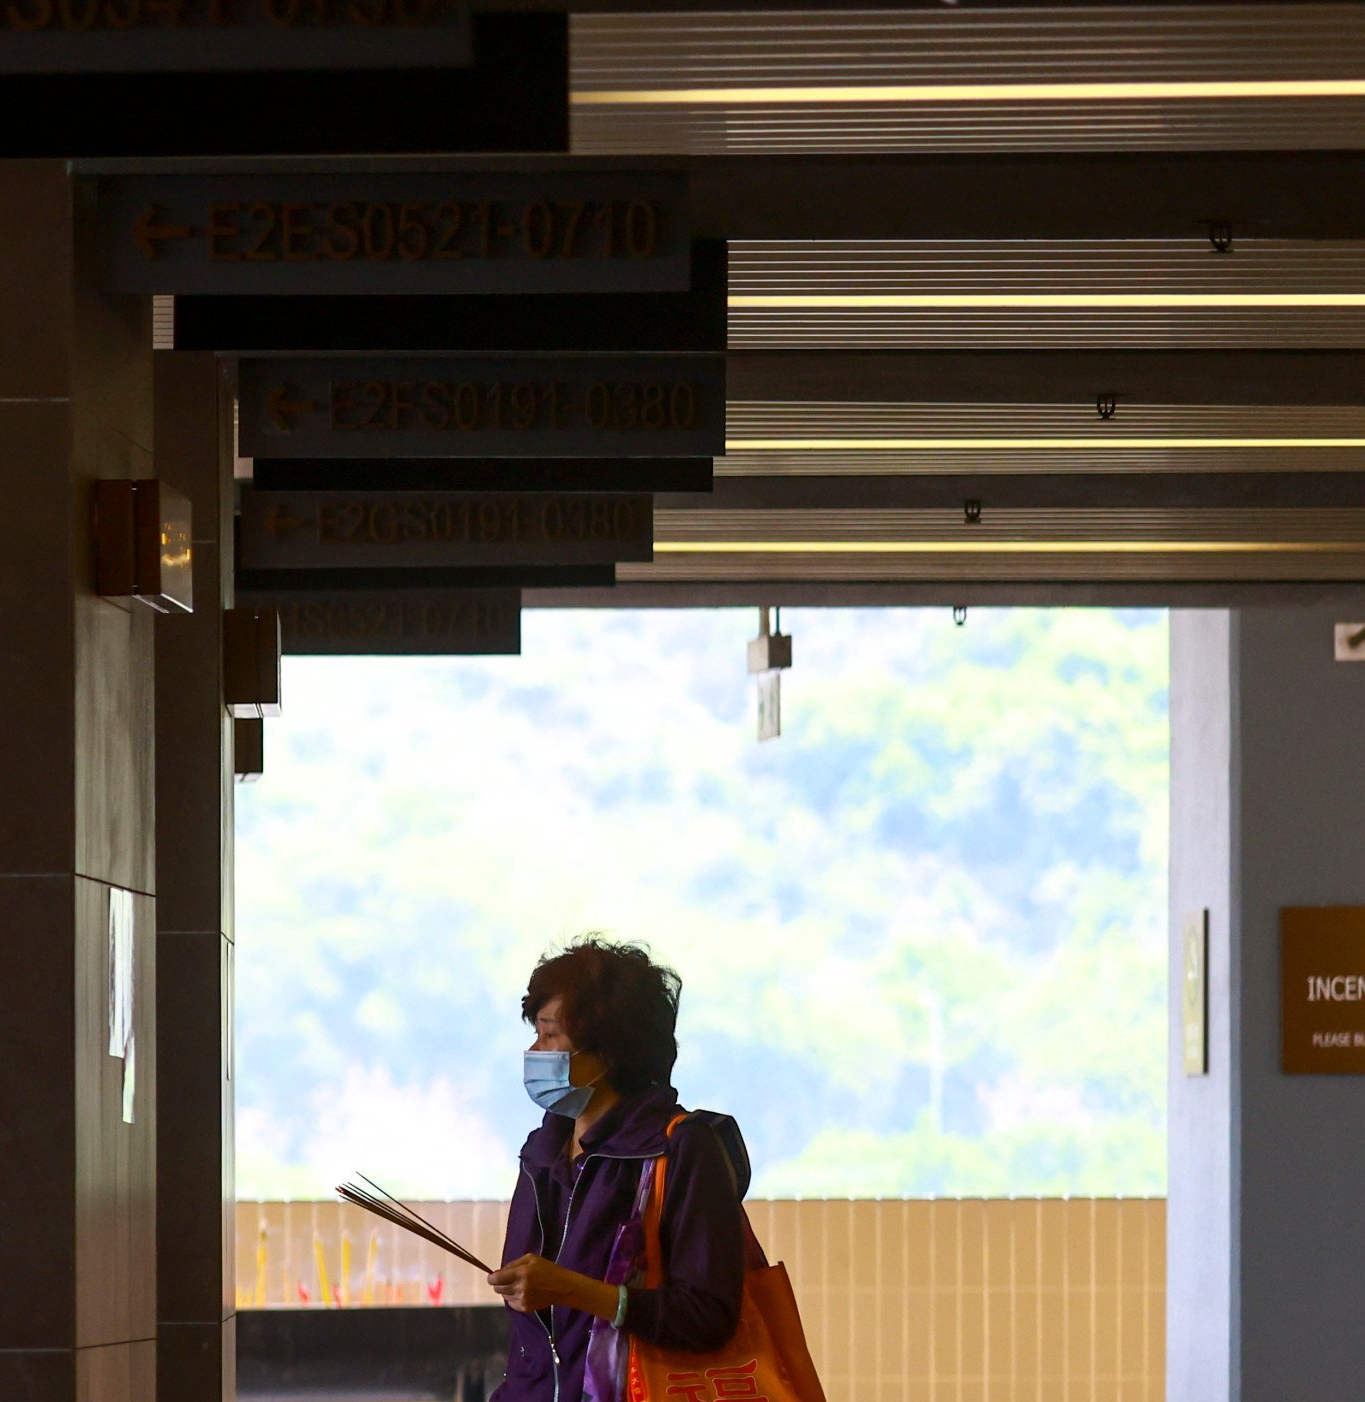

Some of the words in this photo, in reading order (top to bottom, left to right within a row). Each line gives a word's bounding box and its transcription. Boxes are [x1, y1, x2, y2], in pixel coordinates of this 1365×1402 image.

[207, 202, 658, 261] E2ES0521-0710
[328, 381, 696, 431] E2FS0191-0380
[1312, 1031, 1351, 1048] PLEASE
